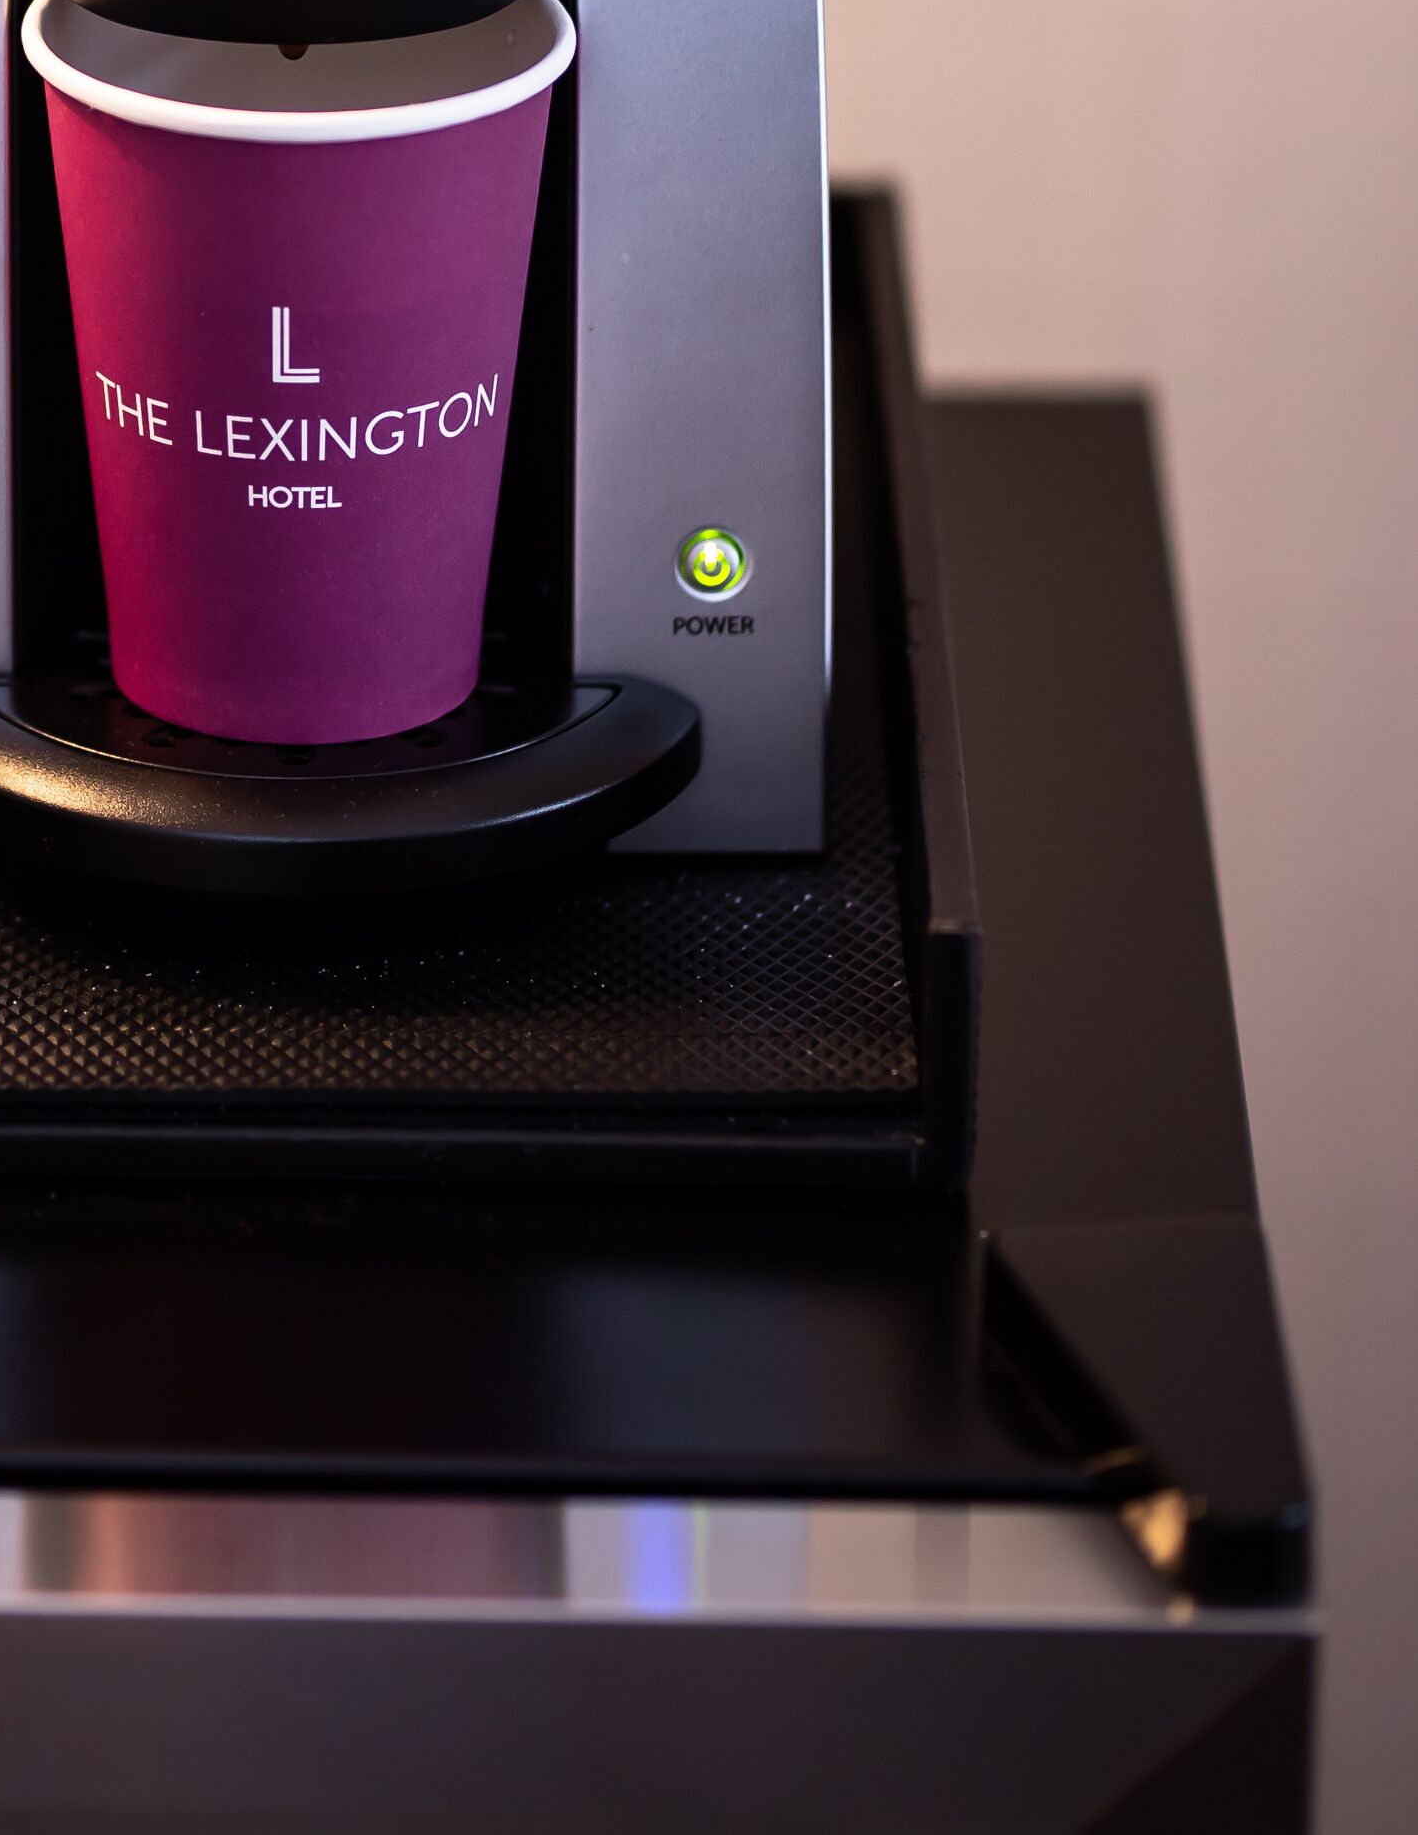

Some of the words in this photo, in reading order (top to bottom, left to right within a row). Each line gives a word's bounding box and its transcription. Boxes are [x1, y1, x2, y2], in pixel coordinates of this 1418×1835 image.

[95, 370, 174, 446] THE
[195, 373, 499, 462] LEXINGTON
[247, 484, 343, 509] HOTEL
[672, 615, 755, 637] POWER
